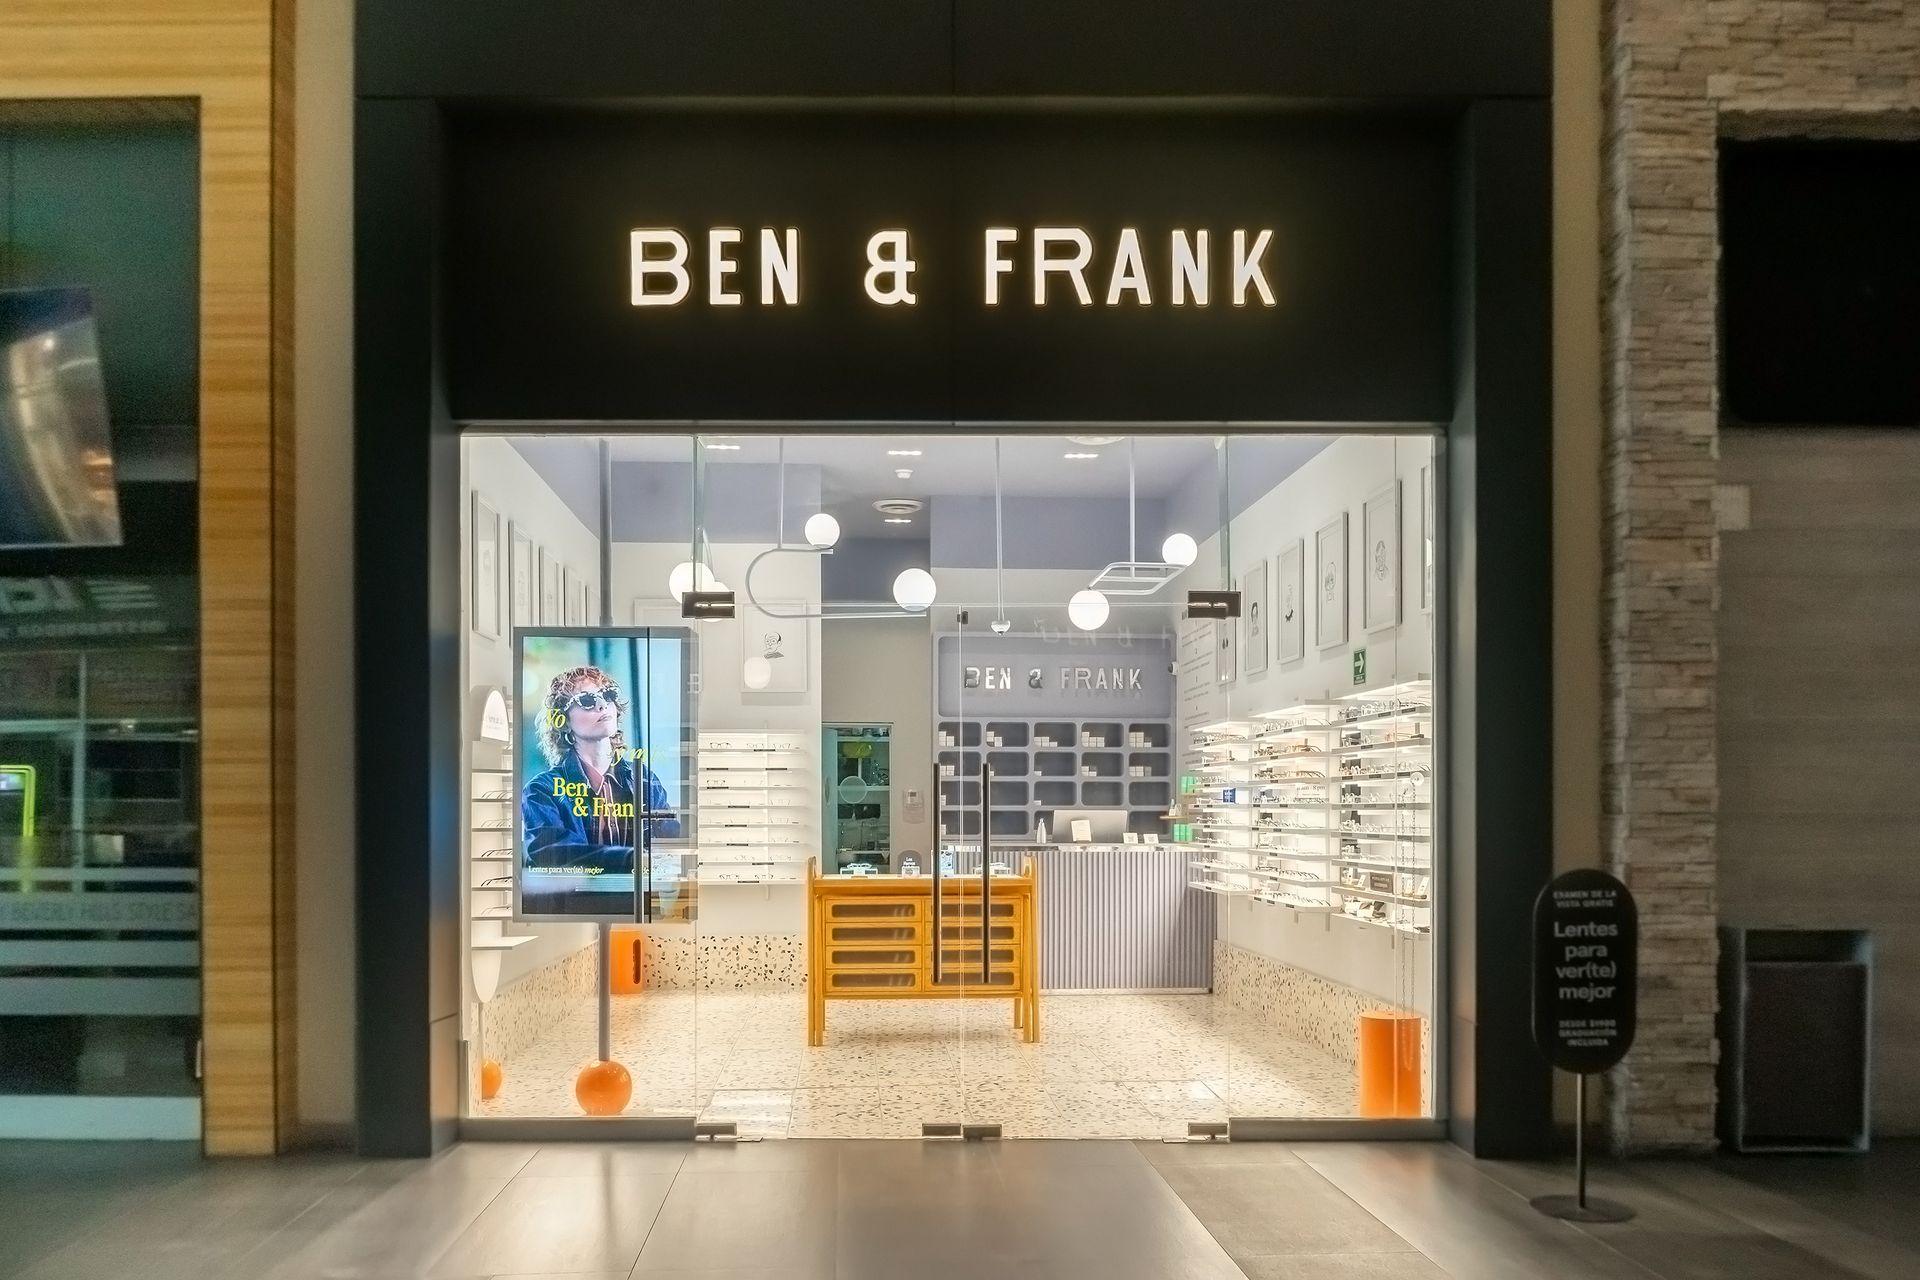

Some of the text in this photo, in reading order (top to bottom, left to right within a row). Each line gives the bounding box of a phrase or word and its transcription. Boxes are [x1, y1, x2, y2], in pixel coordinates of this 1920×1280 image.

[630, 227, 1276, 306] BEN & FRANK
[964, 667, 1142, 690] BEN & FRANK
[552, 777, 589, 798] Ben
[572, 797, 589, 818] &
[549, 867, 562, 875] para
[1553, 920, 1619, 938] Lentes
[1565, 945, 1608, 962] para
[1555, 960, 1617, 979] ver(te)
[1558, 982, 1616, 1003] mejor
